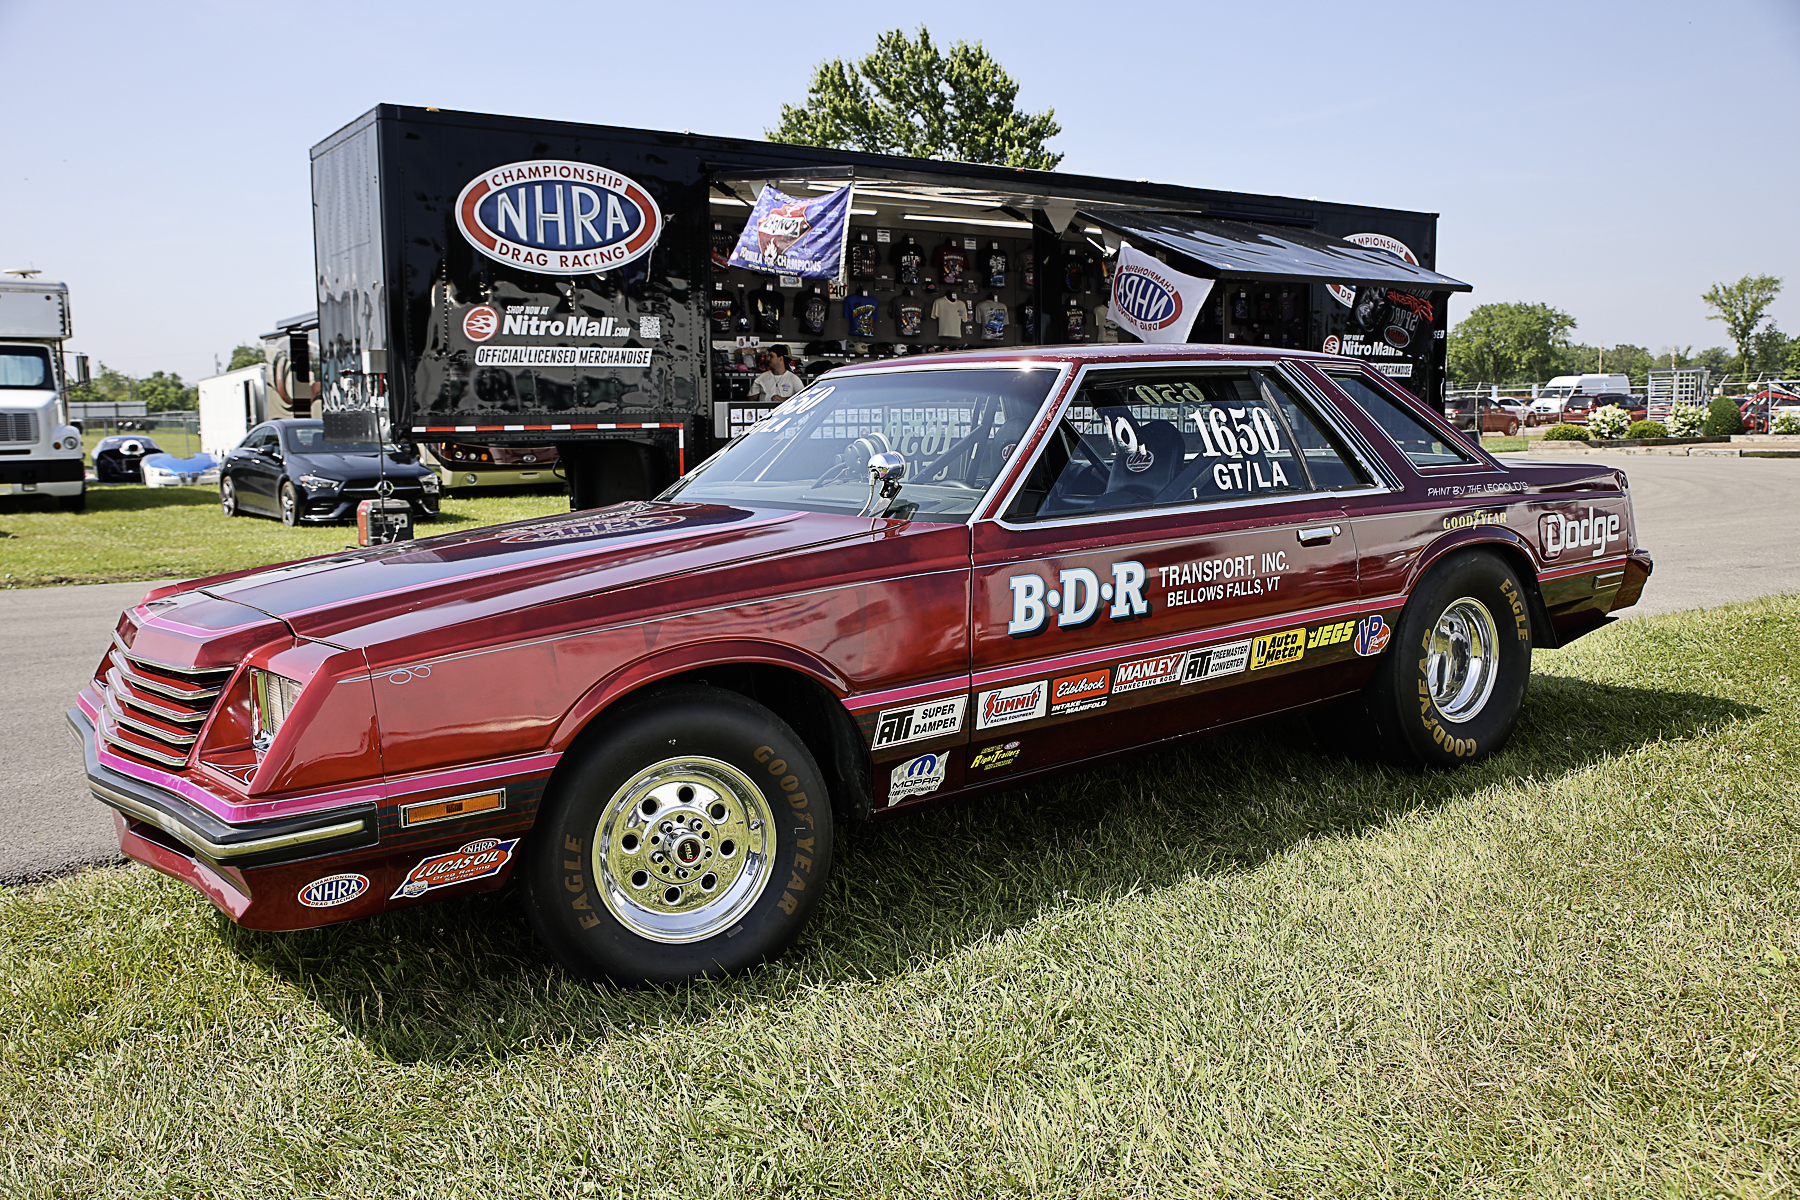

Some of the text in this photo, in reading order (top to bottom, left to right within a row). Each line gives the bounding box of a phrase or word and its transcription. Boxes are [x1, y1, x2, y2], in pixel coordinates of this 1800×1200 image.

[492, 165, 623, 189] CHAMPIONSHIP
[497, 184, 630, 246] NHRA
[1351, 237, 1404, 254] AMPIONSHIP
[498, 243, 625, 268] DRAG RACING
[777, 254, 822, 273] CHAMPIONS
[1340, 286, 1352, 302] DR
[506, 305, 550, 315] SHOP NOW AT
[478, 349, 650, 365] OFFICIAL LICENSED MERCHANDISE
[1189, 406, 1281, 458] 1650
[1212, 461, 1289, 492] GT/LA
[1427, 481, 1529, 497] PAINT BY THE LEOPOLD'S
[1545, 506, 1620, 557] Dodge
[1159, 551, 1290, 588] TRANSPORT, INC.
[1167, 576, 1281, 608] BELLOWS FALLS, VT
[1499, 578, 1529, 641] EAGLE
[1268, 633, 1298, 650] Auto
[1307, 620, 1356, 649] JEGS
[1359, 614, 1383, 656] VP
[1213, 644, 1248, 661] TREEMASTER
[1265, 644, 1303, 664] Meter
[1118, 655, 1177, 684] MANLEY
[1210, 657, 1245, 673] CONVERTER
[1056, 675, 1106, 698] Edelbrock
[1114, 673, 1177, 693] CONNECTING RODS
[921, 703, 956, 720] SUPER
[1051, 699, 1082, 712] INTAKE
[1065, 700, 1108, 715] MANIFOLD
[912, 716, 957, 735] DAMPER
[989, 711, 1035, 724] RACING EQUIPMENT
[891, 776, 941, 789] MOPAR
[466, 841, 494, 853] NHRA
[415, 850, 500, 880] LUCAS OIL
[310, 879, 359, 901] NHRA
[311, 874, 358, 888] CHAMPIONSHIP
[563, 834, 602, 931] EAGLE
[331, 895, 355, 905] RACING
